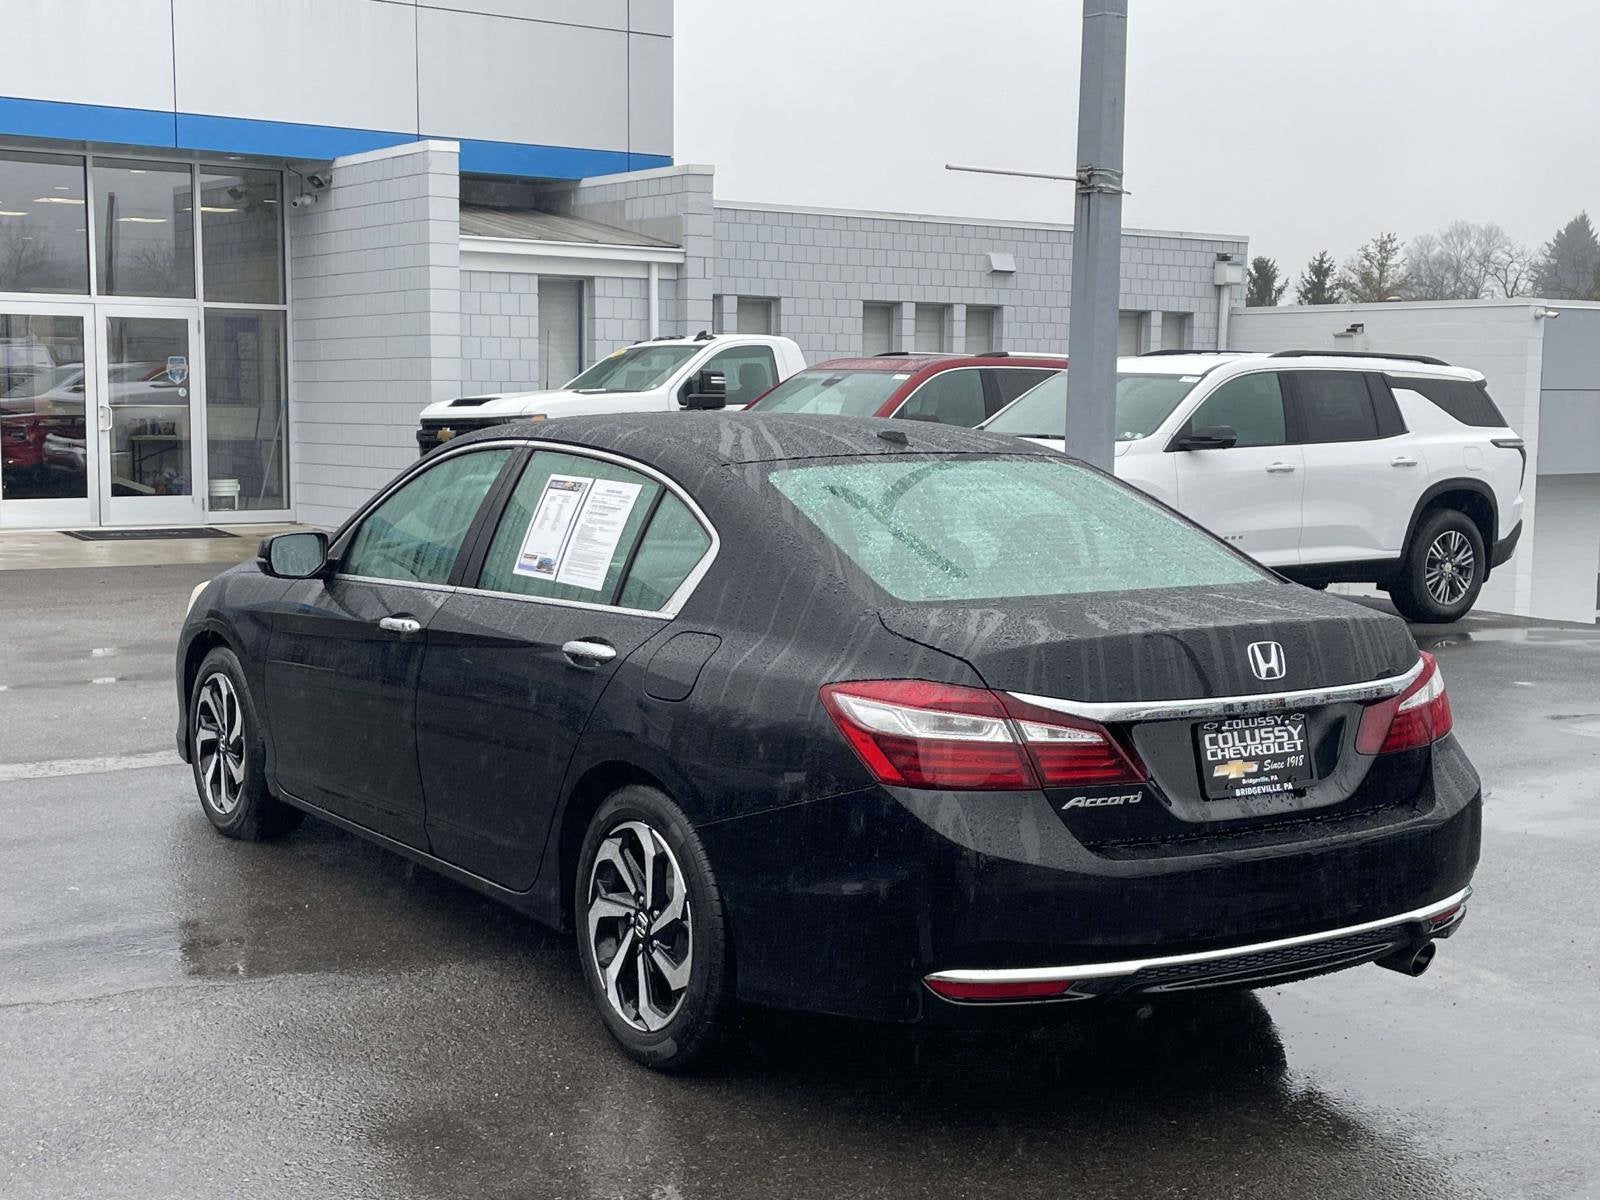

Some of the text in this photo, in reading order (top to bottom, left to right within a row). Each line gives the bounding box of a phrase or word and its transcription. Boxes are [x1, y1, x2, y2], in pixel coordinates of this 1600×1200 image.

[1225, 714, 1284, 731] COLUSSY
[1204, 724, 1303, 750] COLUSSY
[1206, 739, 1304, 761] CHEVROLET
[1263, 754, 1305, 772] Since 1918
[1270, 774, 1279, 782] PA
[1283, 782, 1294, 791] PA
[1061, 791, 1143, 810] Accord
